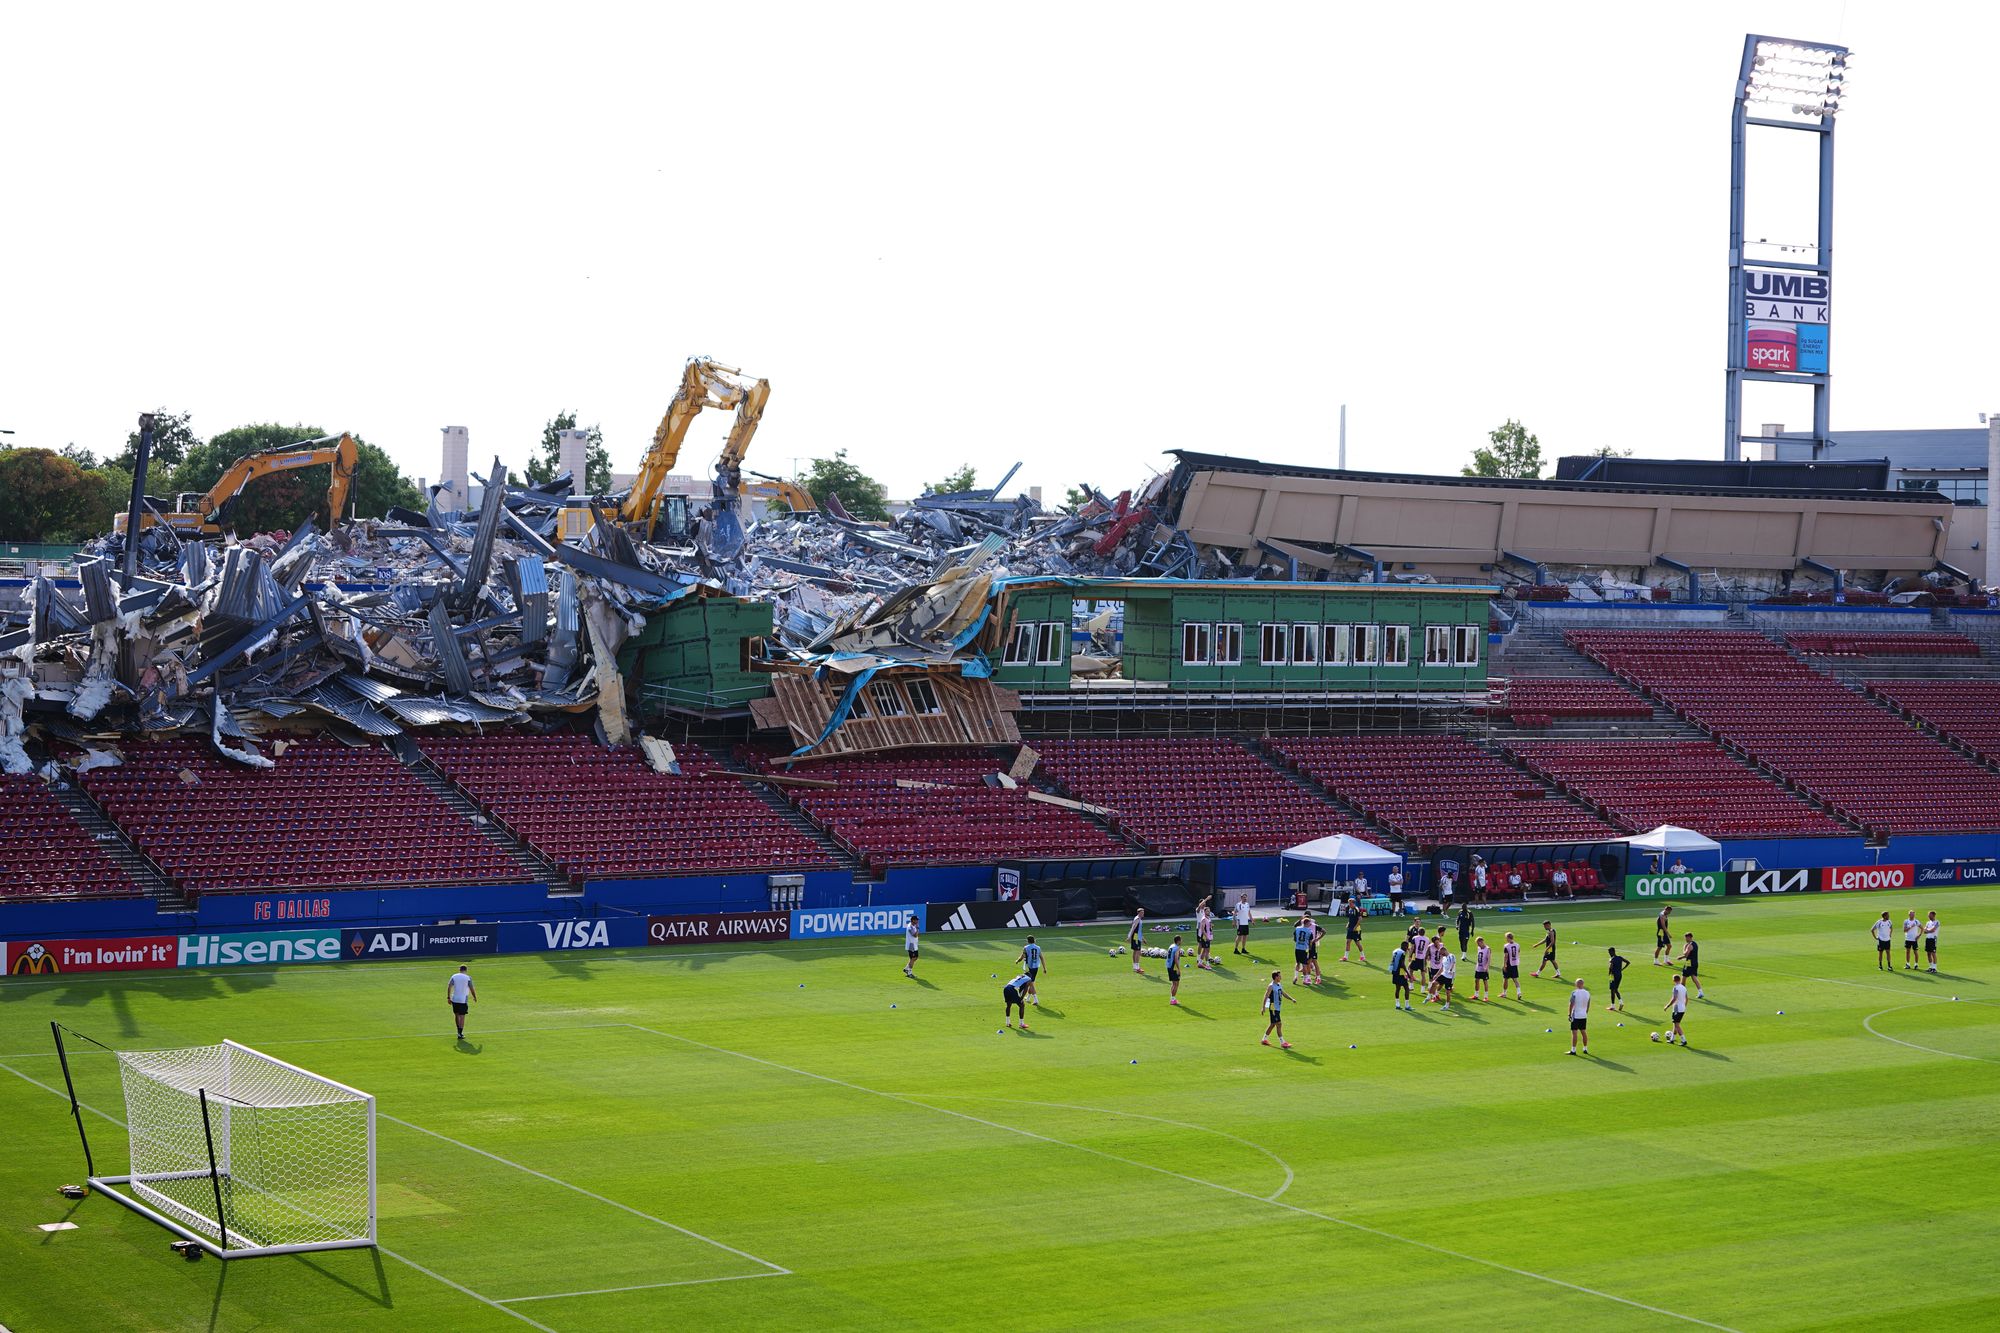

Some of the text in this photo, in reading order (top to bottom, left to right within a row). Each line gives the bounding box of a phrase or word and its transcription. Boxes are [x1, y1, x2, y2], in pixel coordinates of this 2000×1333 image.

[1746, 272, 1828, 299] UMB
[1746, 302, 1827, 321] BANK
[1752, 345, 1790, 364] spark
[1740, 869, 1808, 894] KIA
[1831, 868, 1904, 890] Lenovo
[1964, 868, 1996, 878] ULTRA
[1636, 876, 1716, 896] aramco
[254, 898, 330, 920] FC DALLAS
[650, 916, 788, 942] QATAR AIRWAYS
[799, 909, 916, 934] POWERADE
[368, 932, 488, 953] ADI PREDICTSTREET
[538, 920, 610, 948] VISA
[64, 948, 92, 964] i'm
[97, 946, 148, 964] lovin'
[177, 936, 340, 966] Hisense
